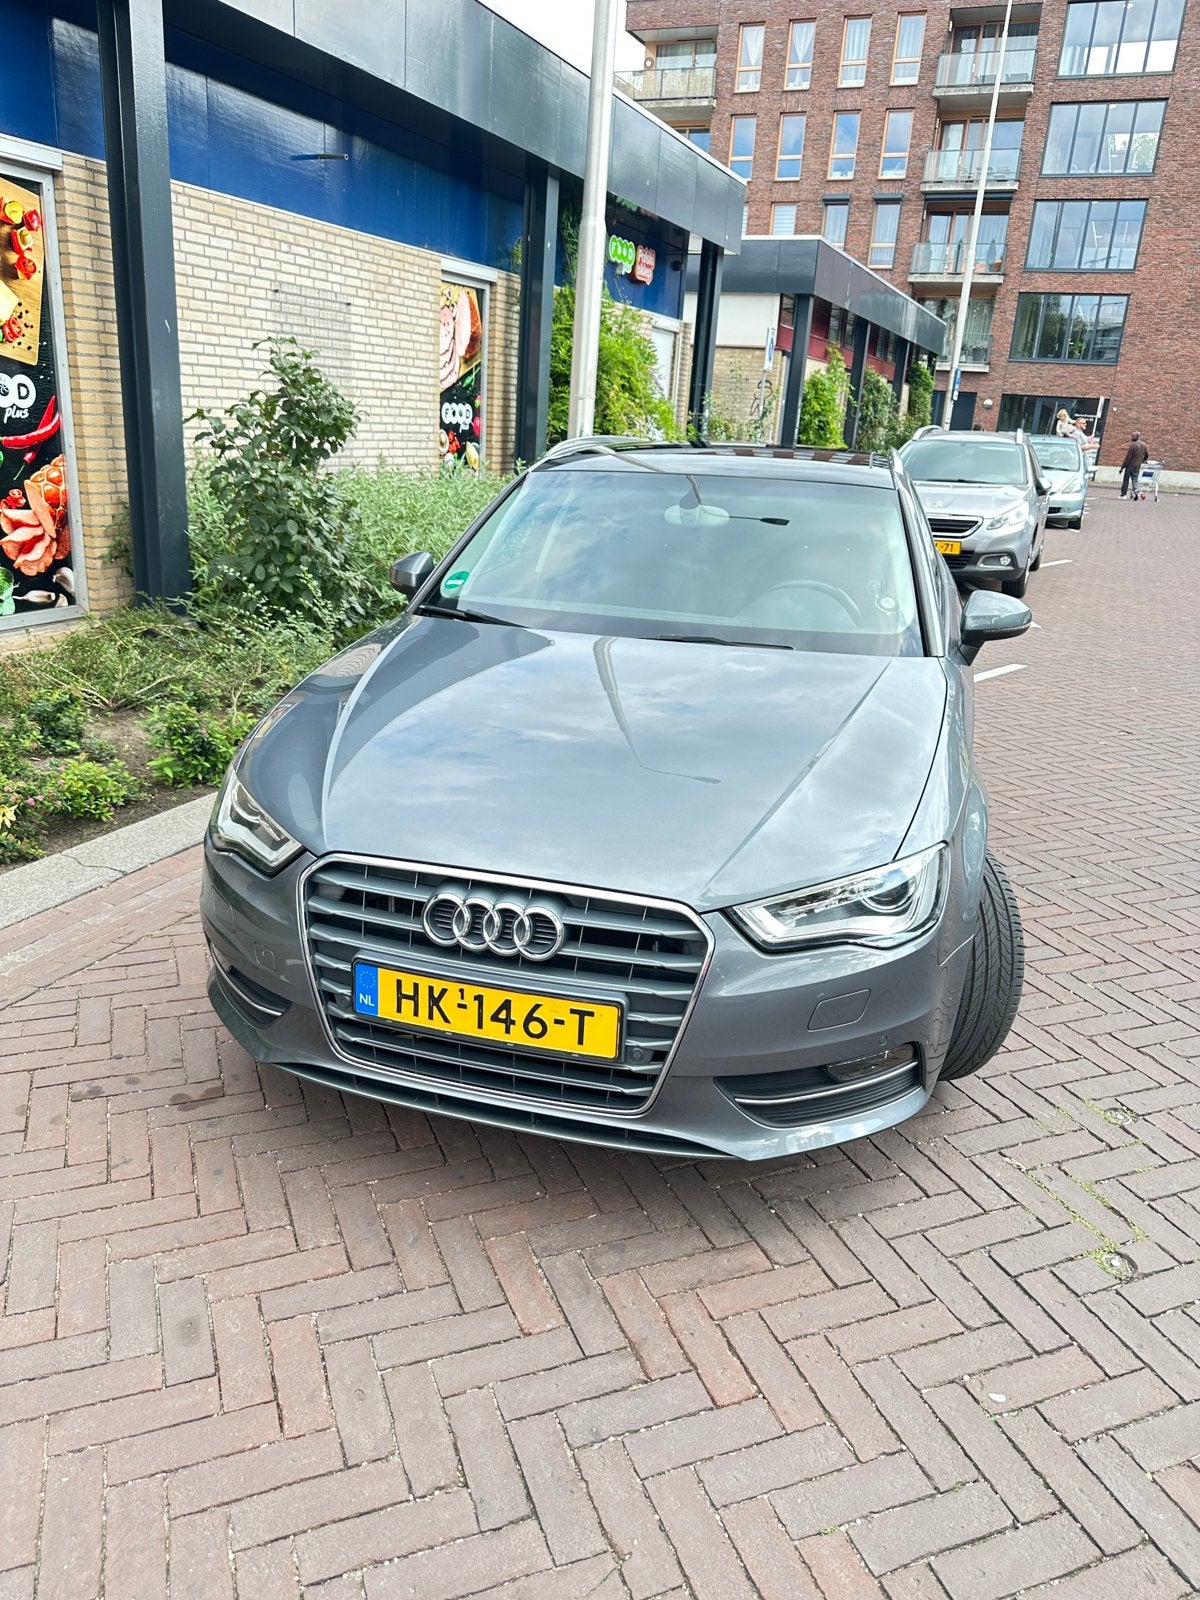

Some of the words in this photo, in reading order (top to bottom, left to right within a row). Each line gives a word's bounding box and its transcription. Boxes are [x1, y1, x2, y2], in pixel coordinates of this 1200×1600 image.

[3, 405, 30, 424] plus
[444, 405, 472, 421] FOOD
[359, 993, 375, 1007] NL
